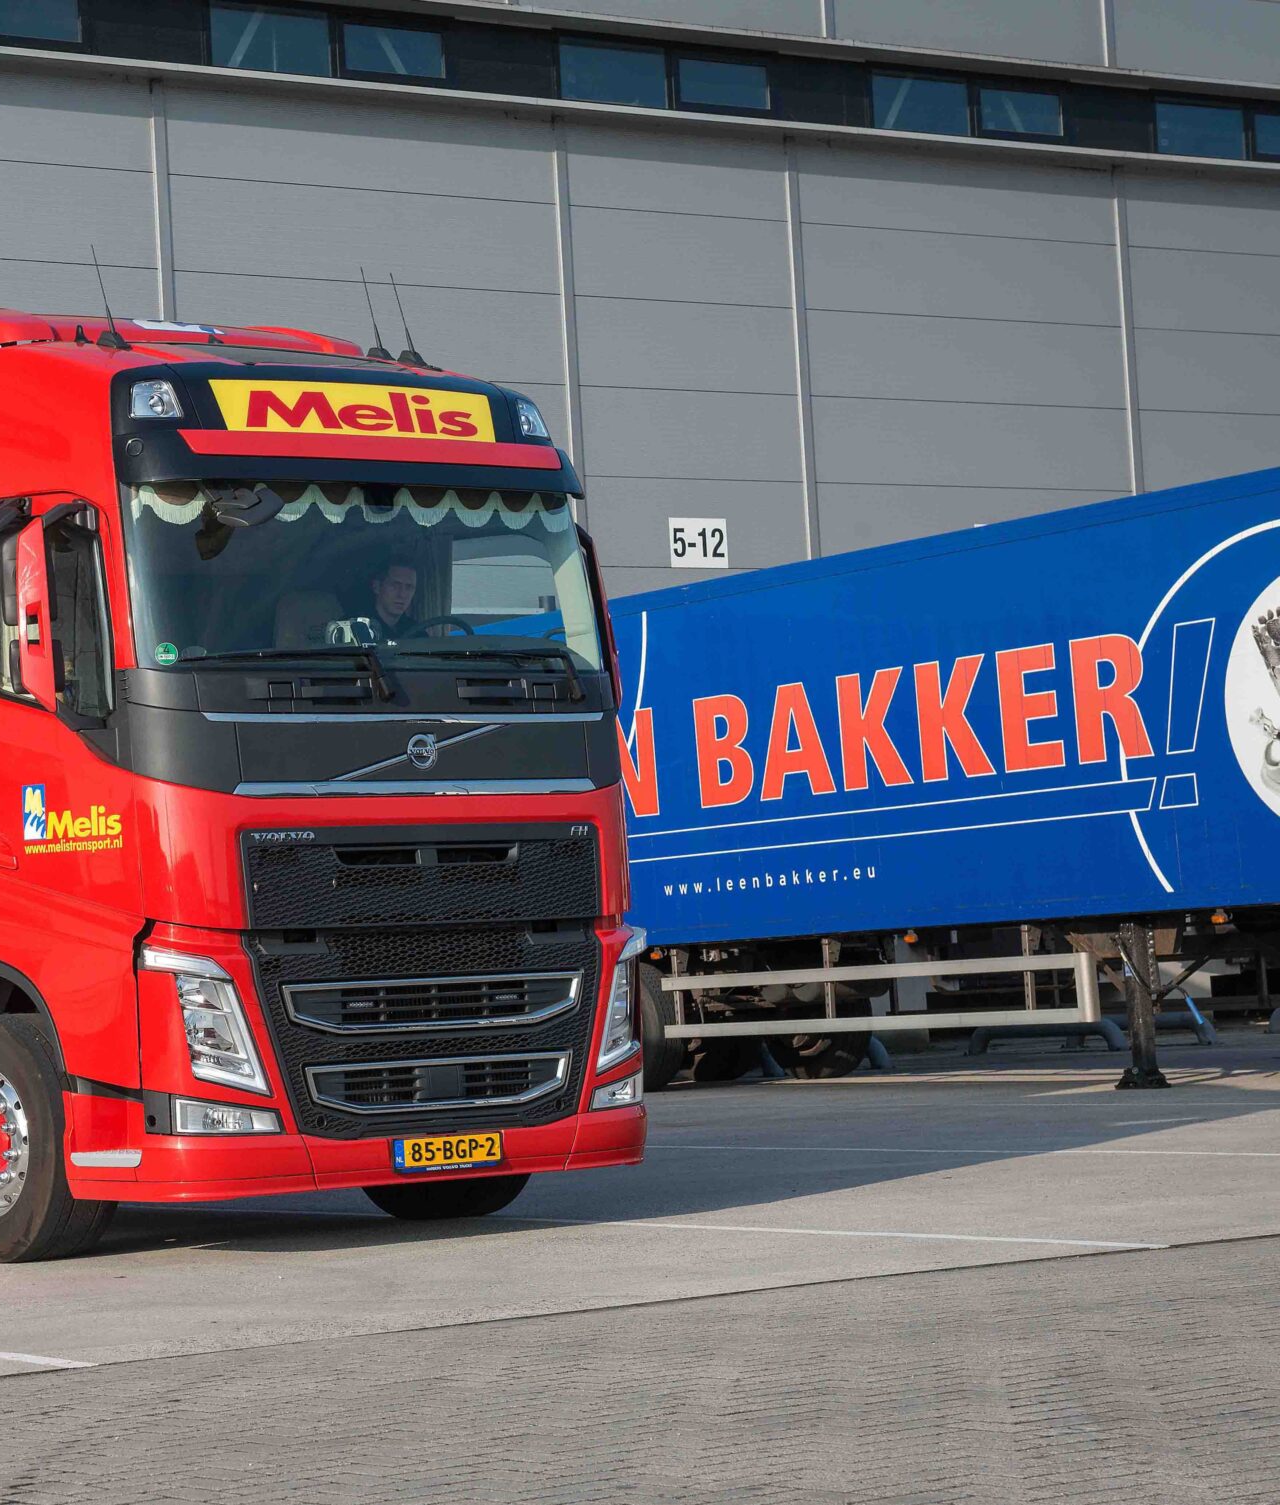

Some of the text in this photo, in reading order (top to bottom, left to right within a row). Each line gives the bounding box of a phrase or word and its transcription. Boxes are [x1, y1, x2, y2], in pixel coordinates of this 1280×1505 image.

[246, 390, 478, 438] Melis
[673, 527, 725, 558] 5-12
[46, 805, 122, 840] Melis
[570, 825, 589, 837] FH
[24, 835, 123, 855] www.melistransport.nl
[251, 831, 315, 844] VOLVO
[664, 866, 876, 896] www.leenbakker.eu
[411, 1137, 496, 1163] 85-BGP-2
